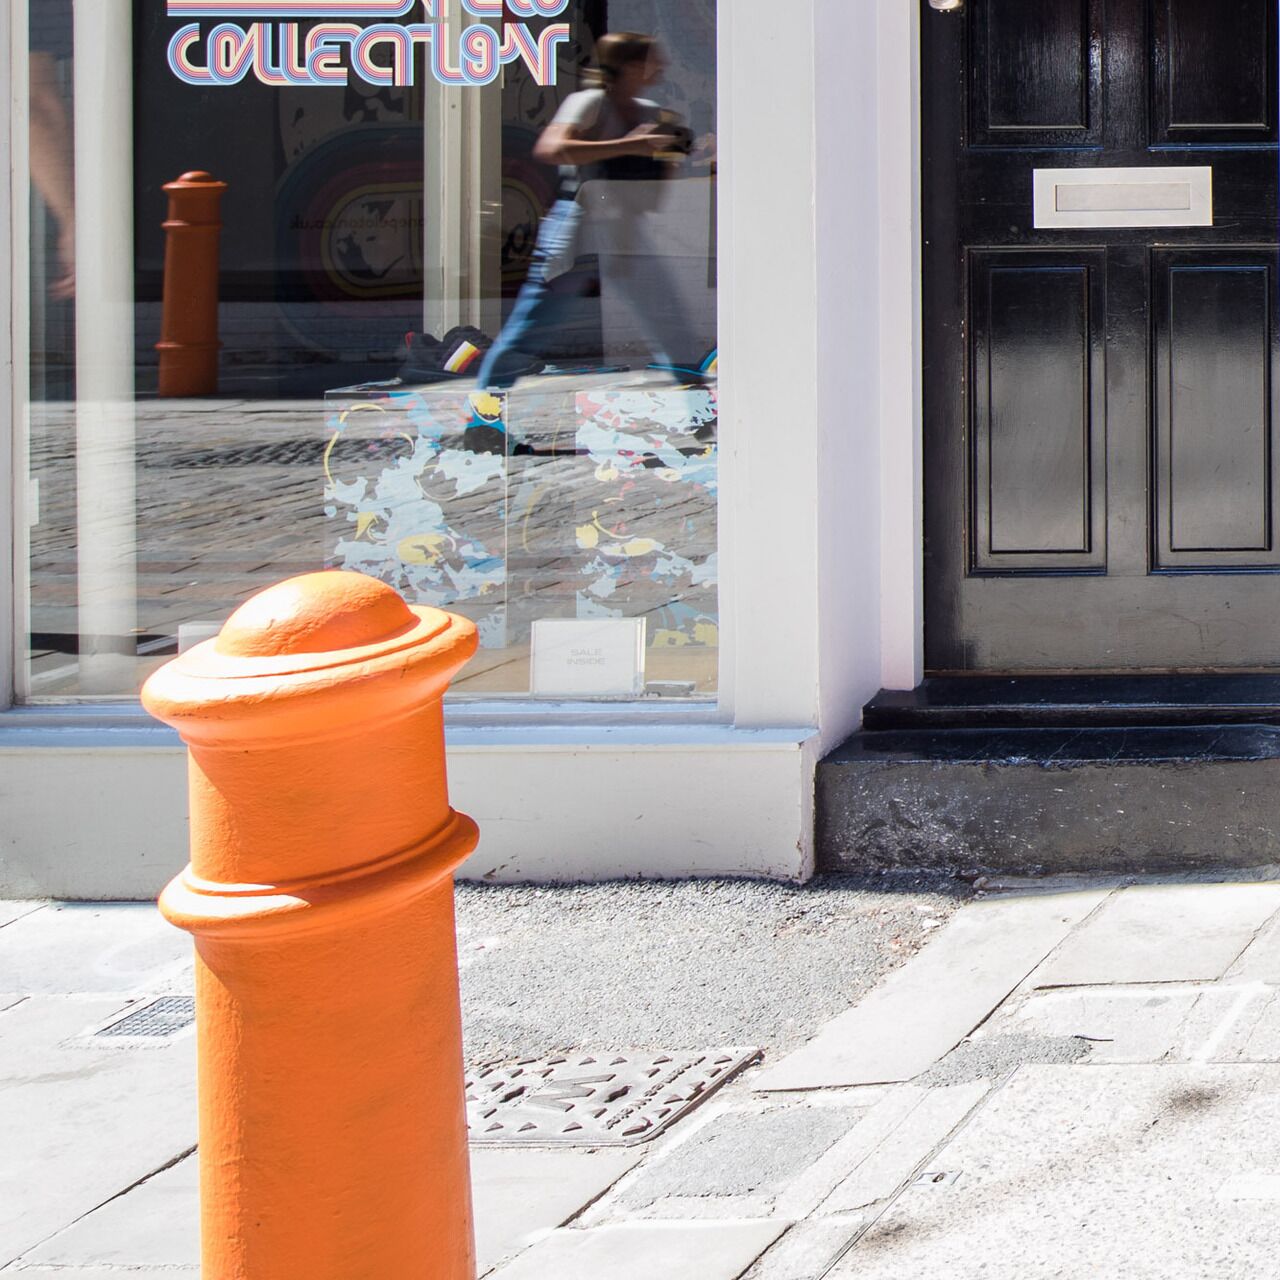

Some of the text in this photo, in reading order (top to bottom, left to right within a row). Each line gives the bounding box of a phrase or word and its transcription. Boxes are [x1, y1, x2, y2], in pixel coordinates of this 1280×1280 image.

[167, 23, 569, 86] COLLECTION
[569, 648, 602, 656] SALE
[566, 657, 608, 665] INSIDE
